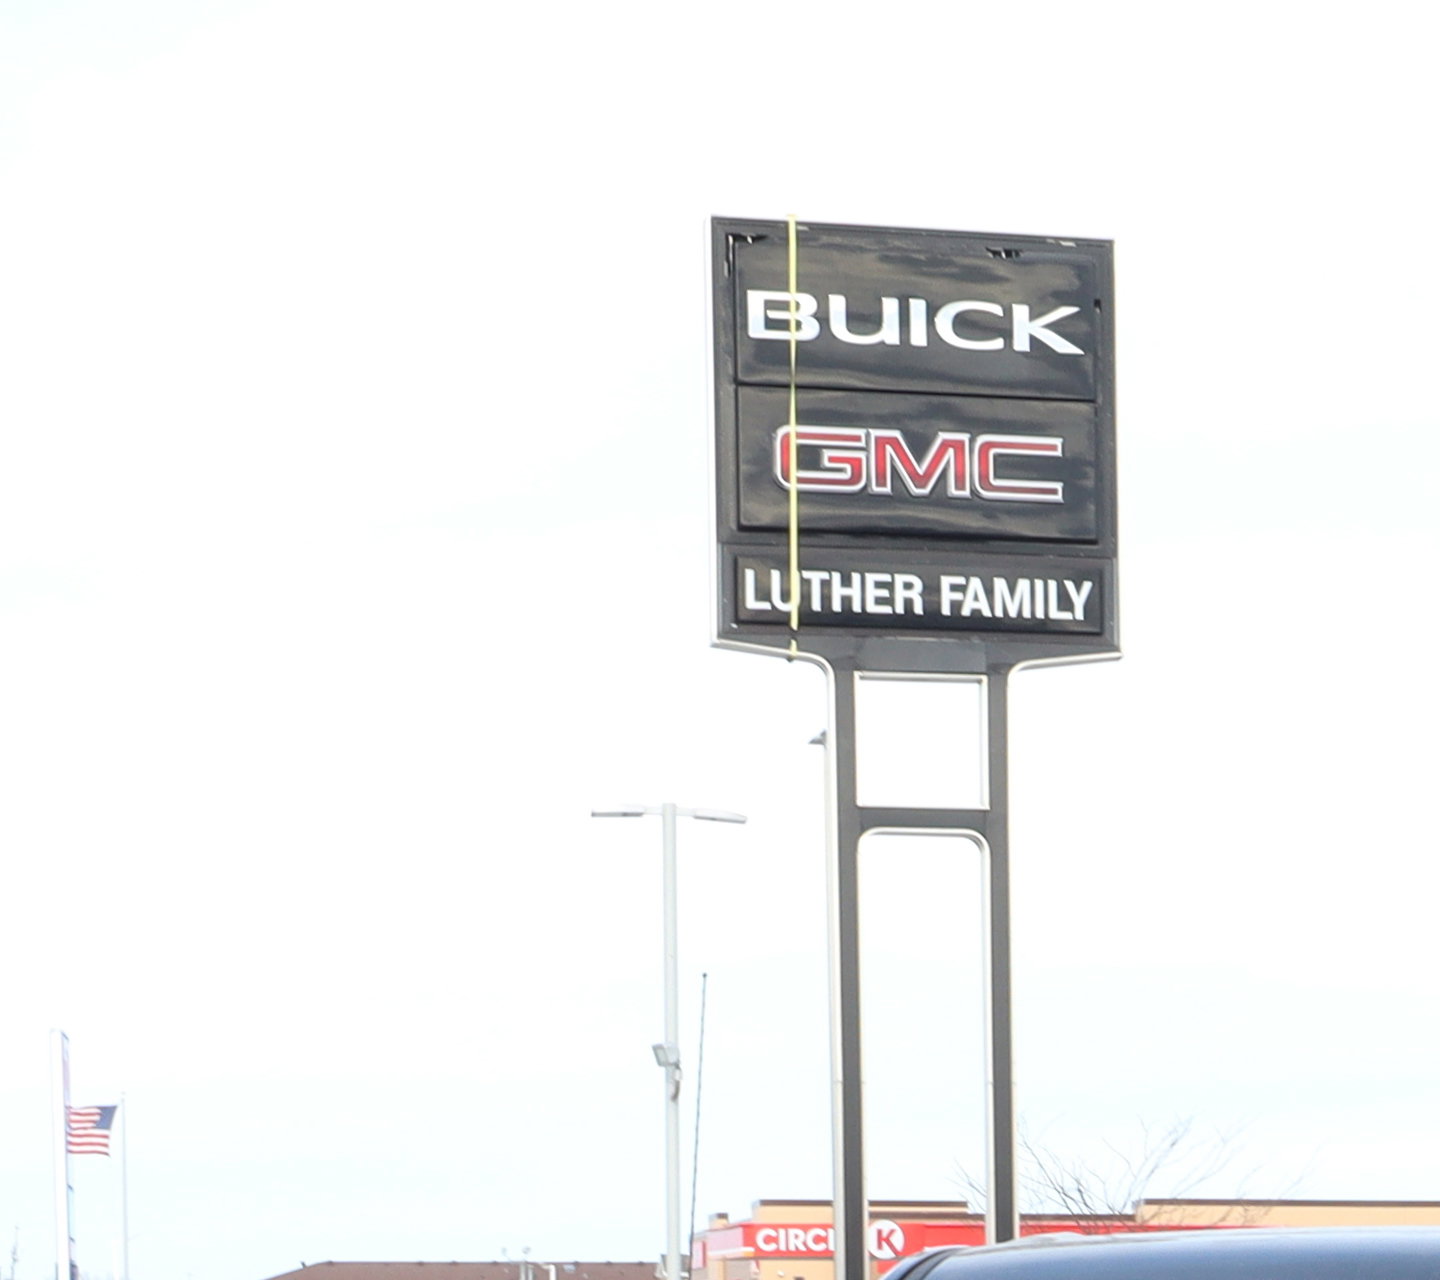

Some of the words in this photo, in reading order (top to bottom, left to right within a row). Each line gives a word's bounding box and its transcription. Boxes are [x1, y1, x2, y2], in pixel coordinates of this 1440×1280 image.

[746, 289, 1086, 355] BUICK
[772, 424, 1064, 503] GMC
[744, 568, 924, 616] LUTHER
[940, 575, 1094, 621] FAMILY
[755, 1227, 835, 1252] CIRCL
